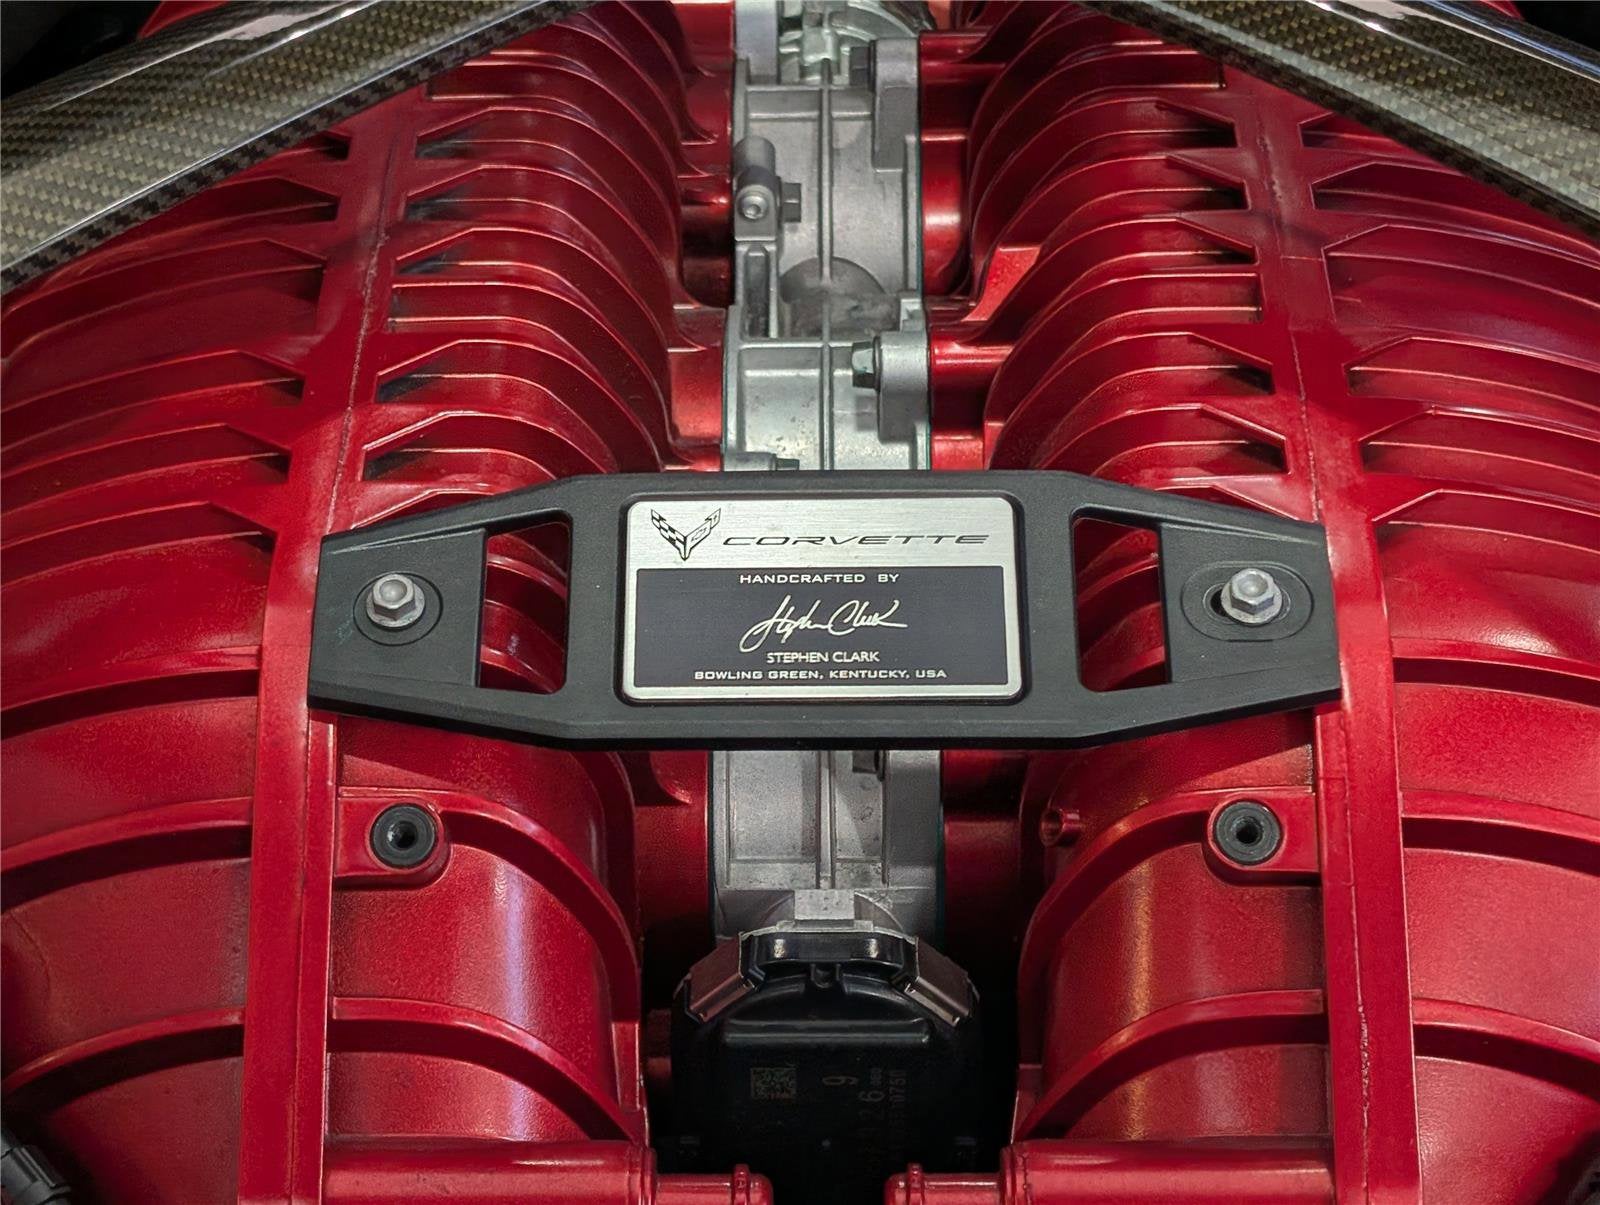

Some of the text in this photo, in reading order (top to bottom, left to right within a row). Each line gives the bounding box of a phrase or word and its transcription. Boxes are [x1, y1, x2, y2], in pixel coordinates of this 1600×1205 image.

[722, 534, 988, 546] CORVETTE
[739, 573, 900, 584] HANDCRAFTED BY
[766, 650, 881, 664] STEPHEN CLARK
[694, 669, 948, 681] BOWLING GREEN, KENTUCKY, USA
